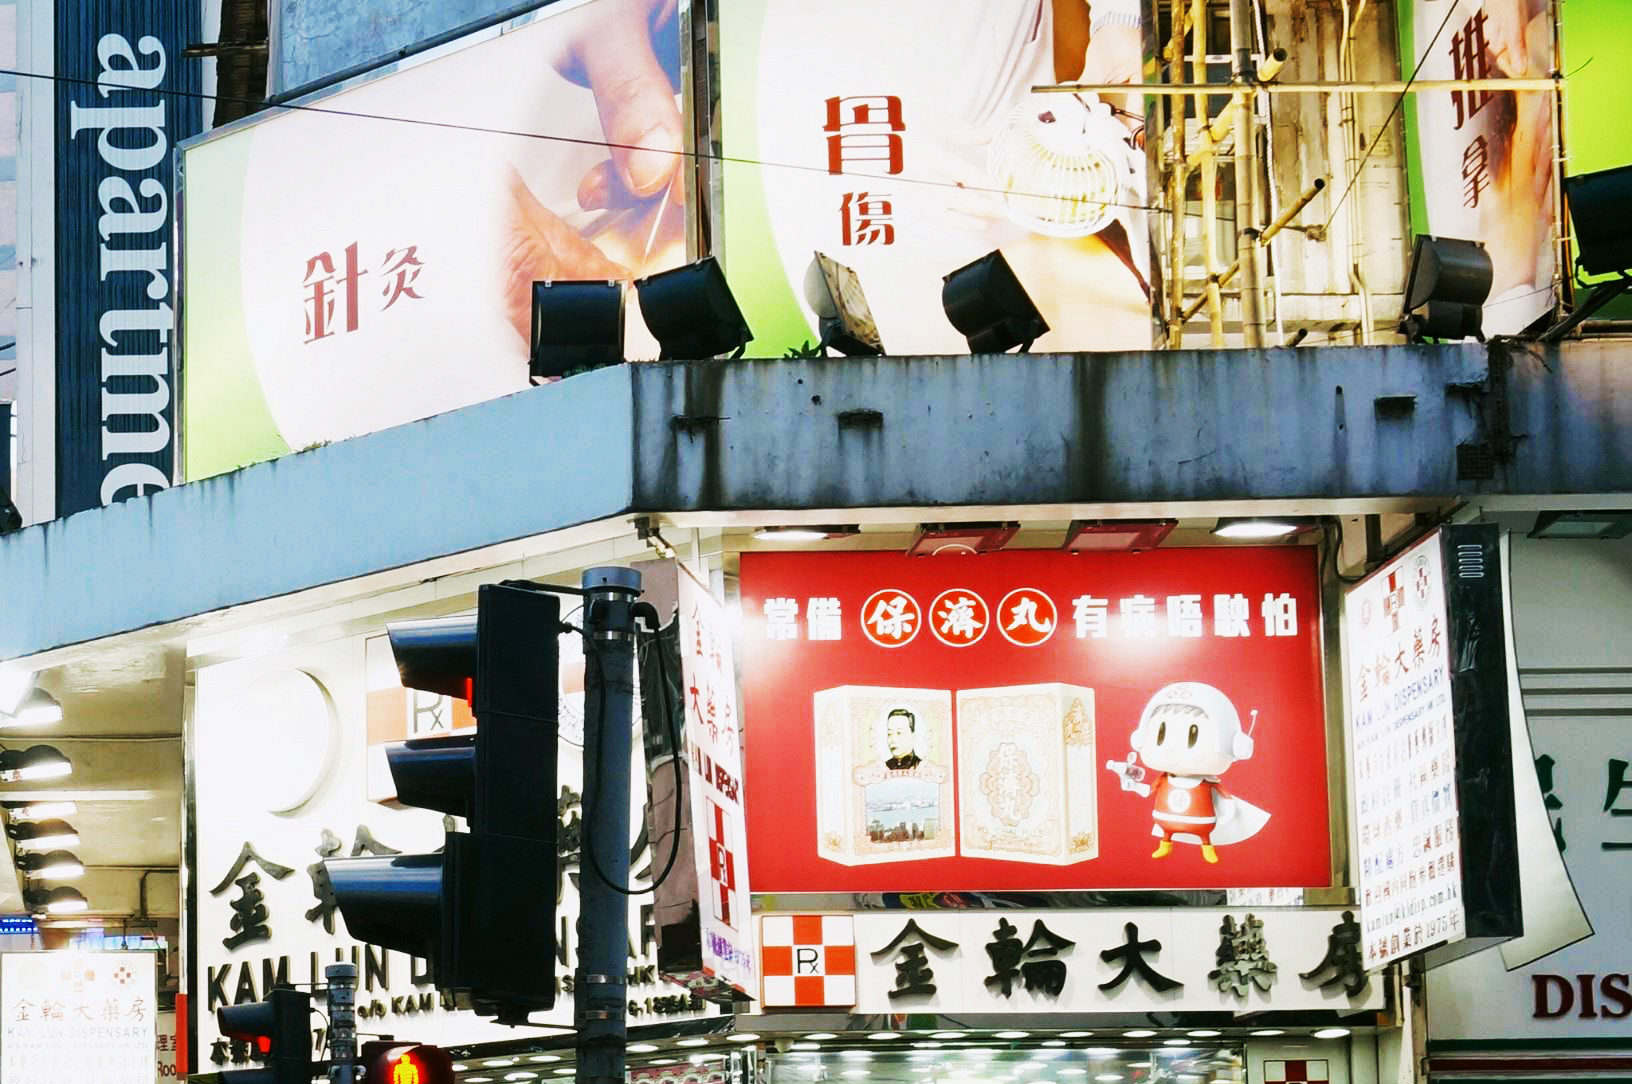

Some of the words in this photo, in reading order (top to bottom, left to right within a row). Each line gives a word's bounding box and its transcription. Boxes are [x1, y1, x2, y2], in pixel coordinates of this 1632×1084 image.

[1448, 6, 1491, 210] 推拿
[822, 93, 907, 247] 骨傷
[302, 240, 427, 346] 針灸
[763, 597, 842, 641] 常備
[870, 910, 1365, 1003] 金輪大藥房
[13, 998, 149, 1022] 金輪大藥房
[1531, 973, 1632, 1019] DIS
[69, 1027, 150, 1039] DISPENSARY
